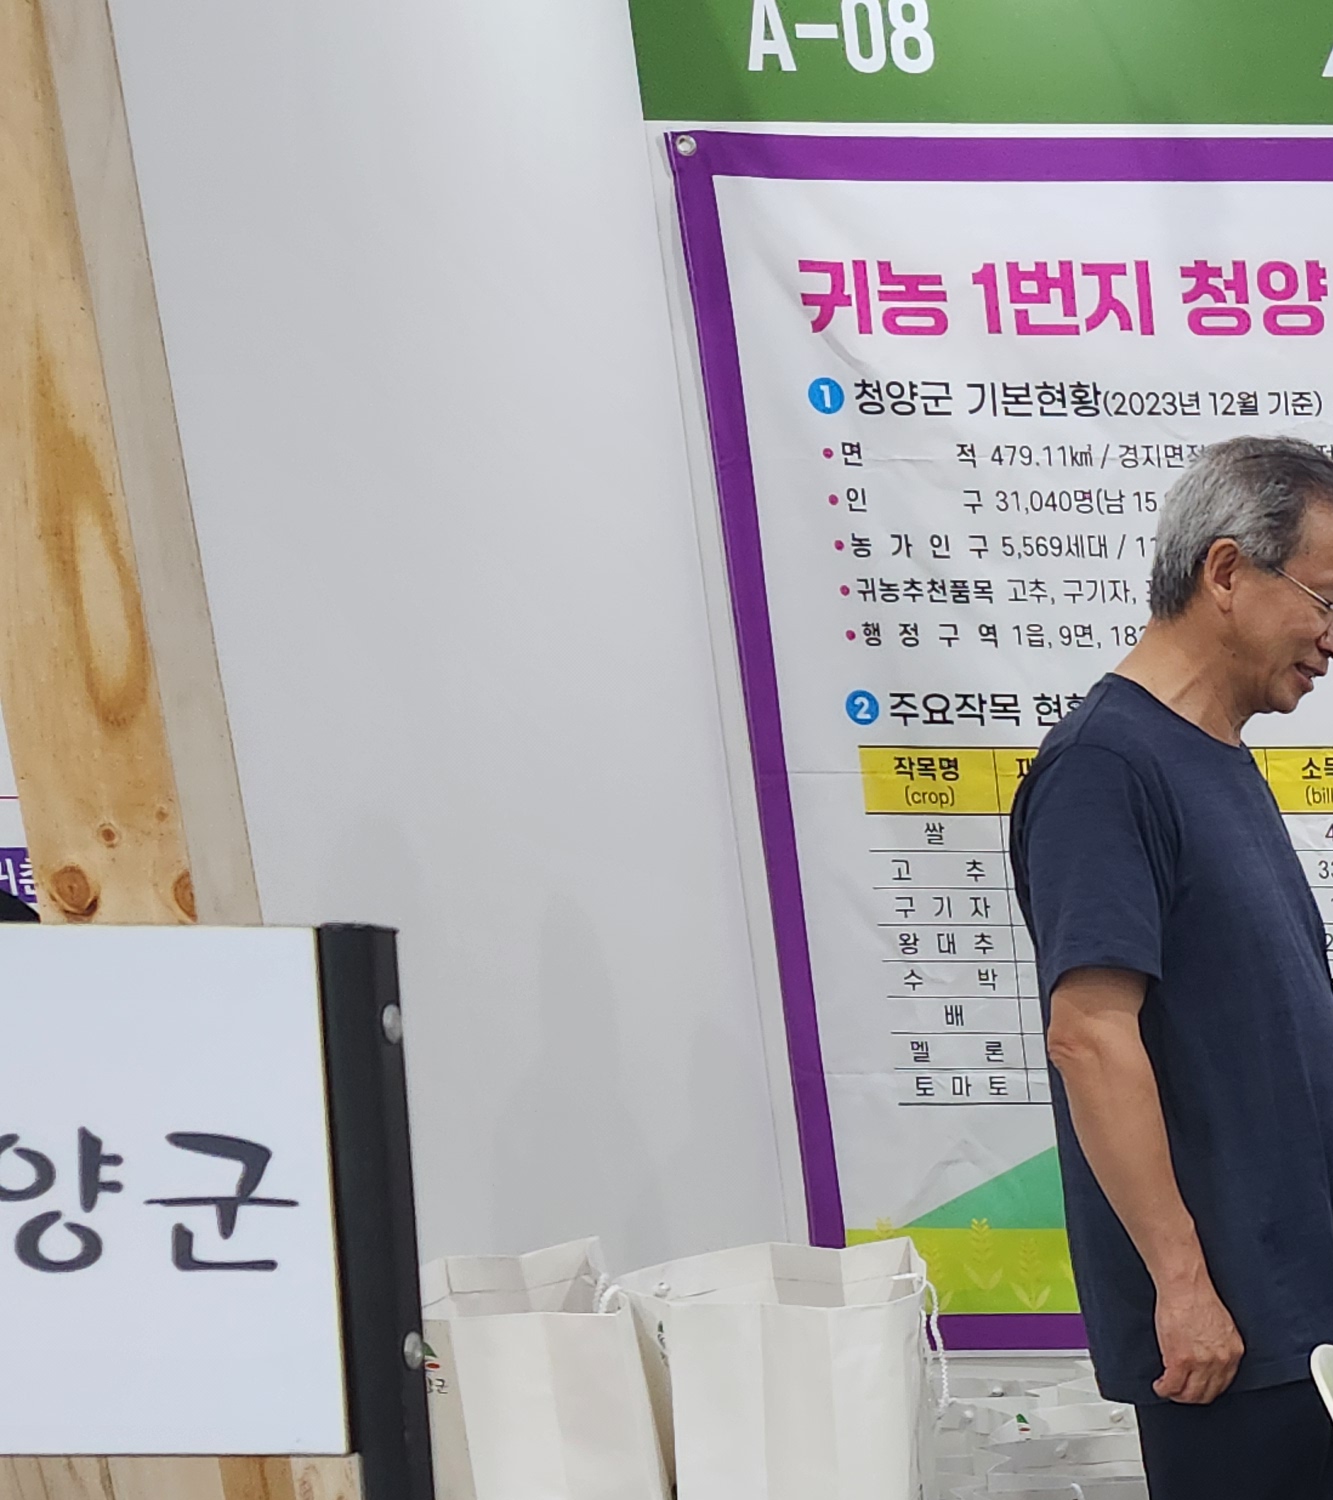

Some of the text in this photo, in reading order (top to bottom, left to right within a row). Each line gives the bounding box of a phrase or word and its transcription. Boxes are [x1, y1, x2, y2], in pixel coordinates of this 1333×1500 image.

[748, 0, 935, 73] A-08
[799, 260, 949, 337] 귀농
[976, 260, 1155, 337] 1번지
[853, 380, 952, 417] 청양군
[1212, 391, 1260, 417] 12월
[1268, 391, 1322, 417] 기준)
[1001, 535, 1108, 559] 5,569세대
[856, 578, 1137, 606] 귀농추천품목 고추, 구기자,
[1012, 625, 1052, 650] 1읍,
[1059, 625, 1101, 650] 9면,
[889, 693, 1021, 728] 주요작목
[893, 756, 960, 782] 작목명
[904, 785, 955, 807] (crop)
[924, 823, 945, 845] 쌀
[944, 1004, 965, 1026] 배
